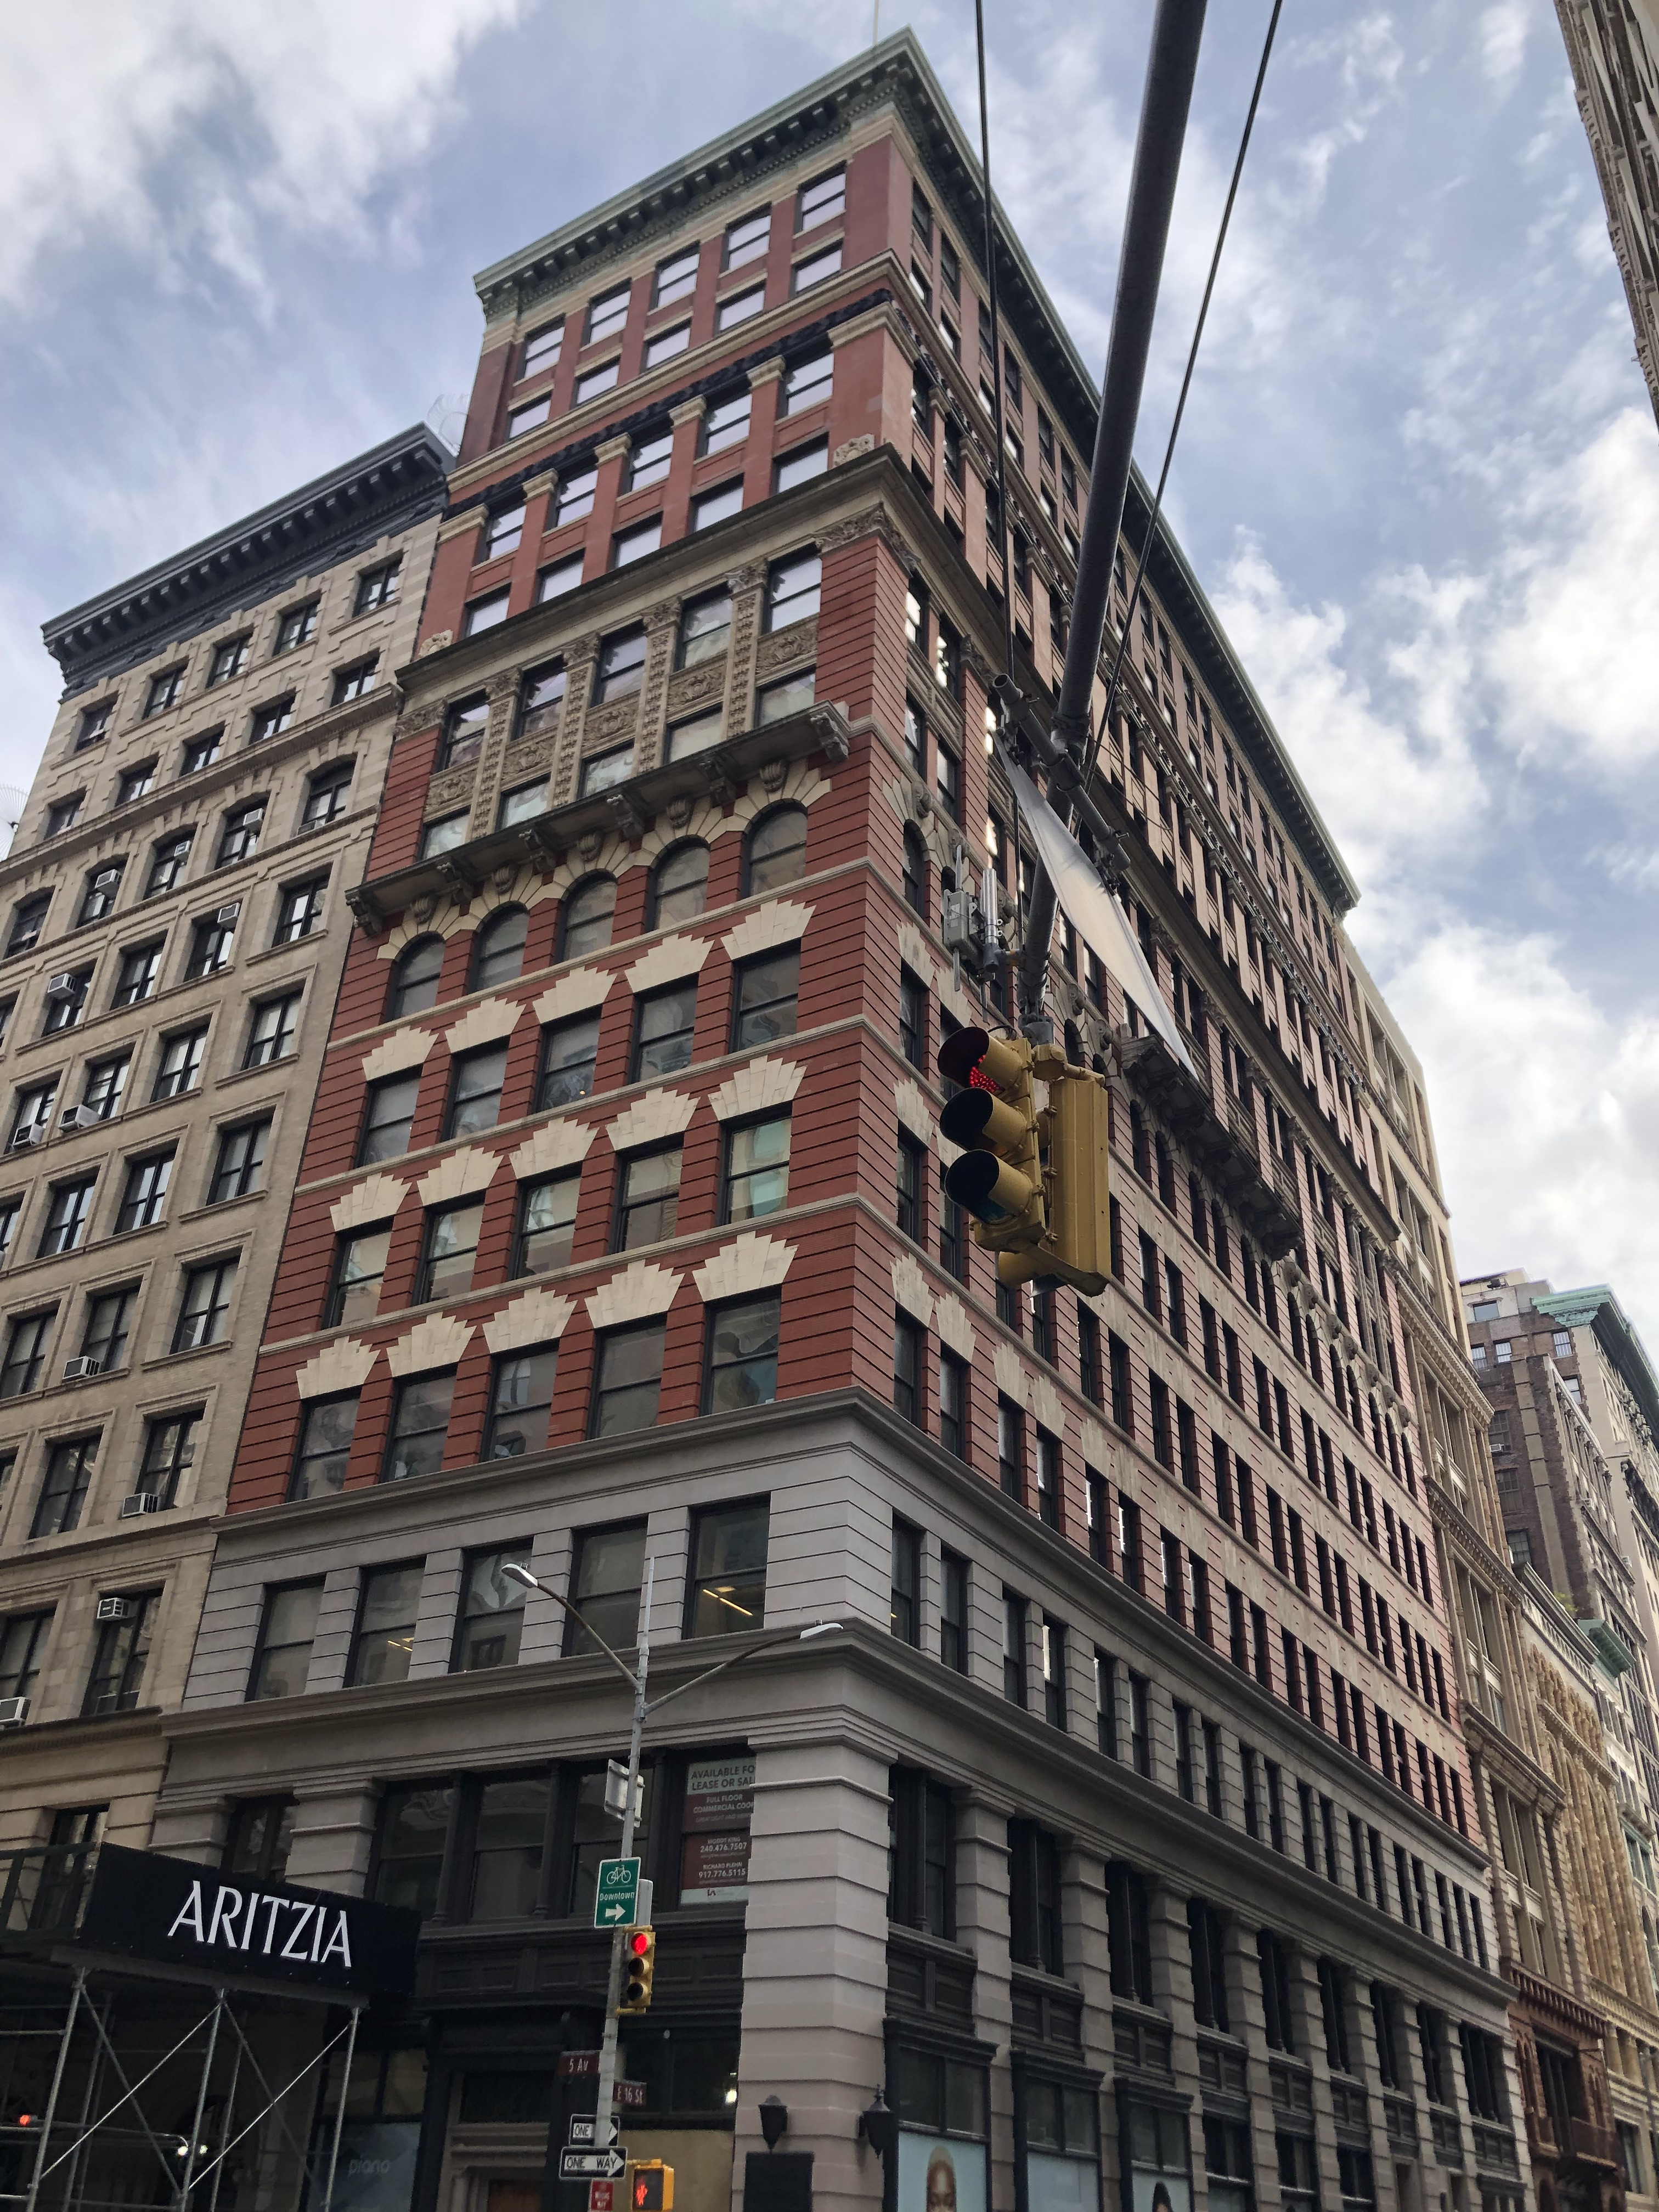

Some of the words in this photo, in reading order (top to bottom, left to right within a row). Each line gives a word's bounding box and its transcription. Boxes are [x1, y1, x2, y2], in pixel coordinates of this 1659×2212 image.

[691, 1767, 740, 1779] AVAILABLE
[742, 1765, 754, 1774] FO
[692, 1780, 719, 1790] LEASE
[721, 1779, 735, 1787] OR
[737, 1776, 754, 1786] SAL
[693, 1803, 735, 1814] COMMERCIAL
[700, 1842, 747, 1853] 240.476.7507
[698, 1868, 746, 1878] 917.776.5115
[600, 1892, 635, 1901] Downtown
[167, 1880, 352, 1968] ARITZIA
[568, 2058, 574, 2073] 5
[577, 2058, 589, 2073] Av
[617, 2085, 622, 2101] E
[625, 2087, 632, 2102] 16
[634, 2089, 643, 2104] St
[575, 2125, 589, 2136] ONE
[567, 2157, 586, 2168] ONE
[597, 2157, 617, 2169] WAY
